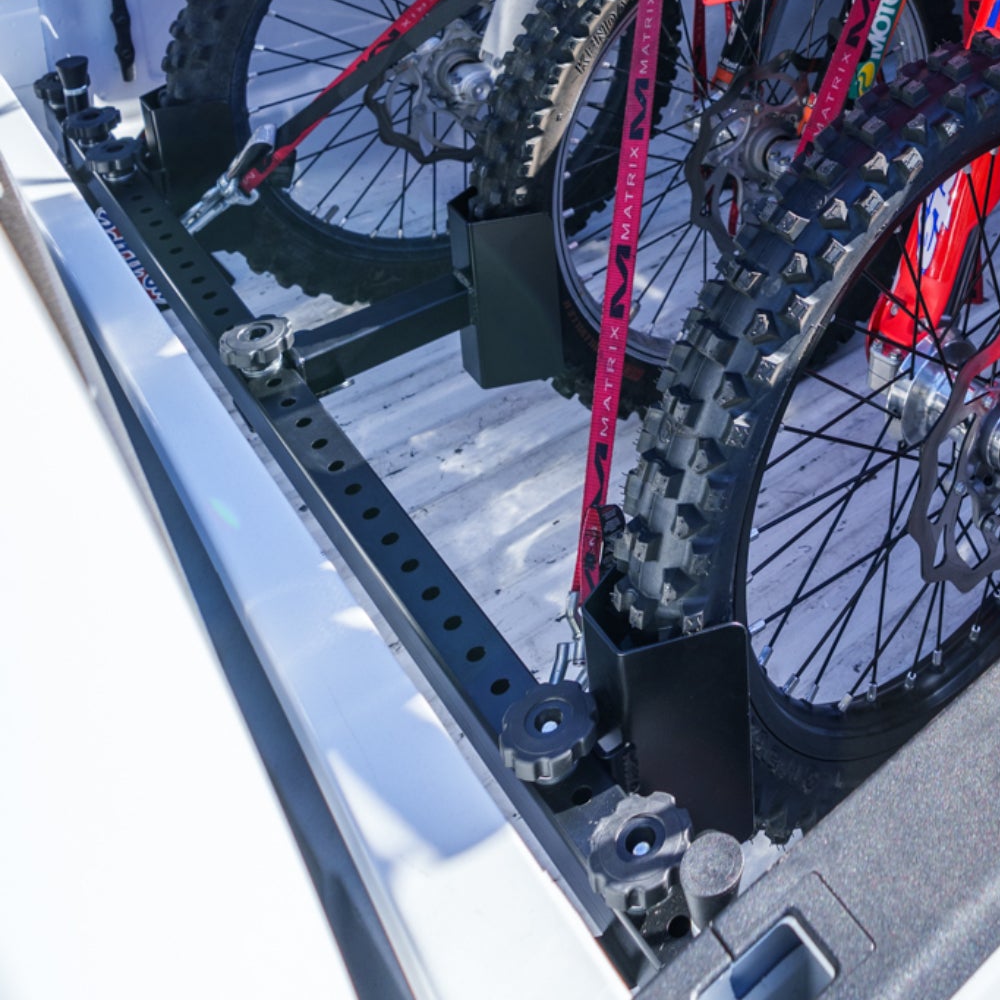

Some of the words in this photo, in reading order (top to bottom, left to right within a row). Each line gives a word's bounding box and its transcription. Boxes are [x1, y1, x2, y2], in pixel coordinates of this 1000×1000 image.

[813, 52, 852, 137] MATRIX
[620, 145, 640, 241] MATRIX
[599, 324, 620, 438] MATRIX
